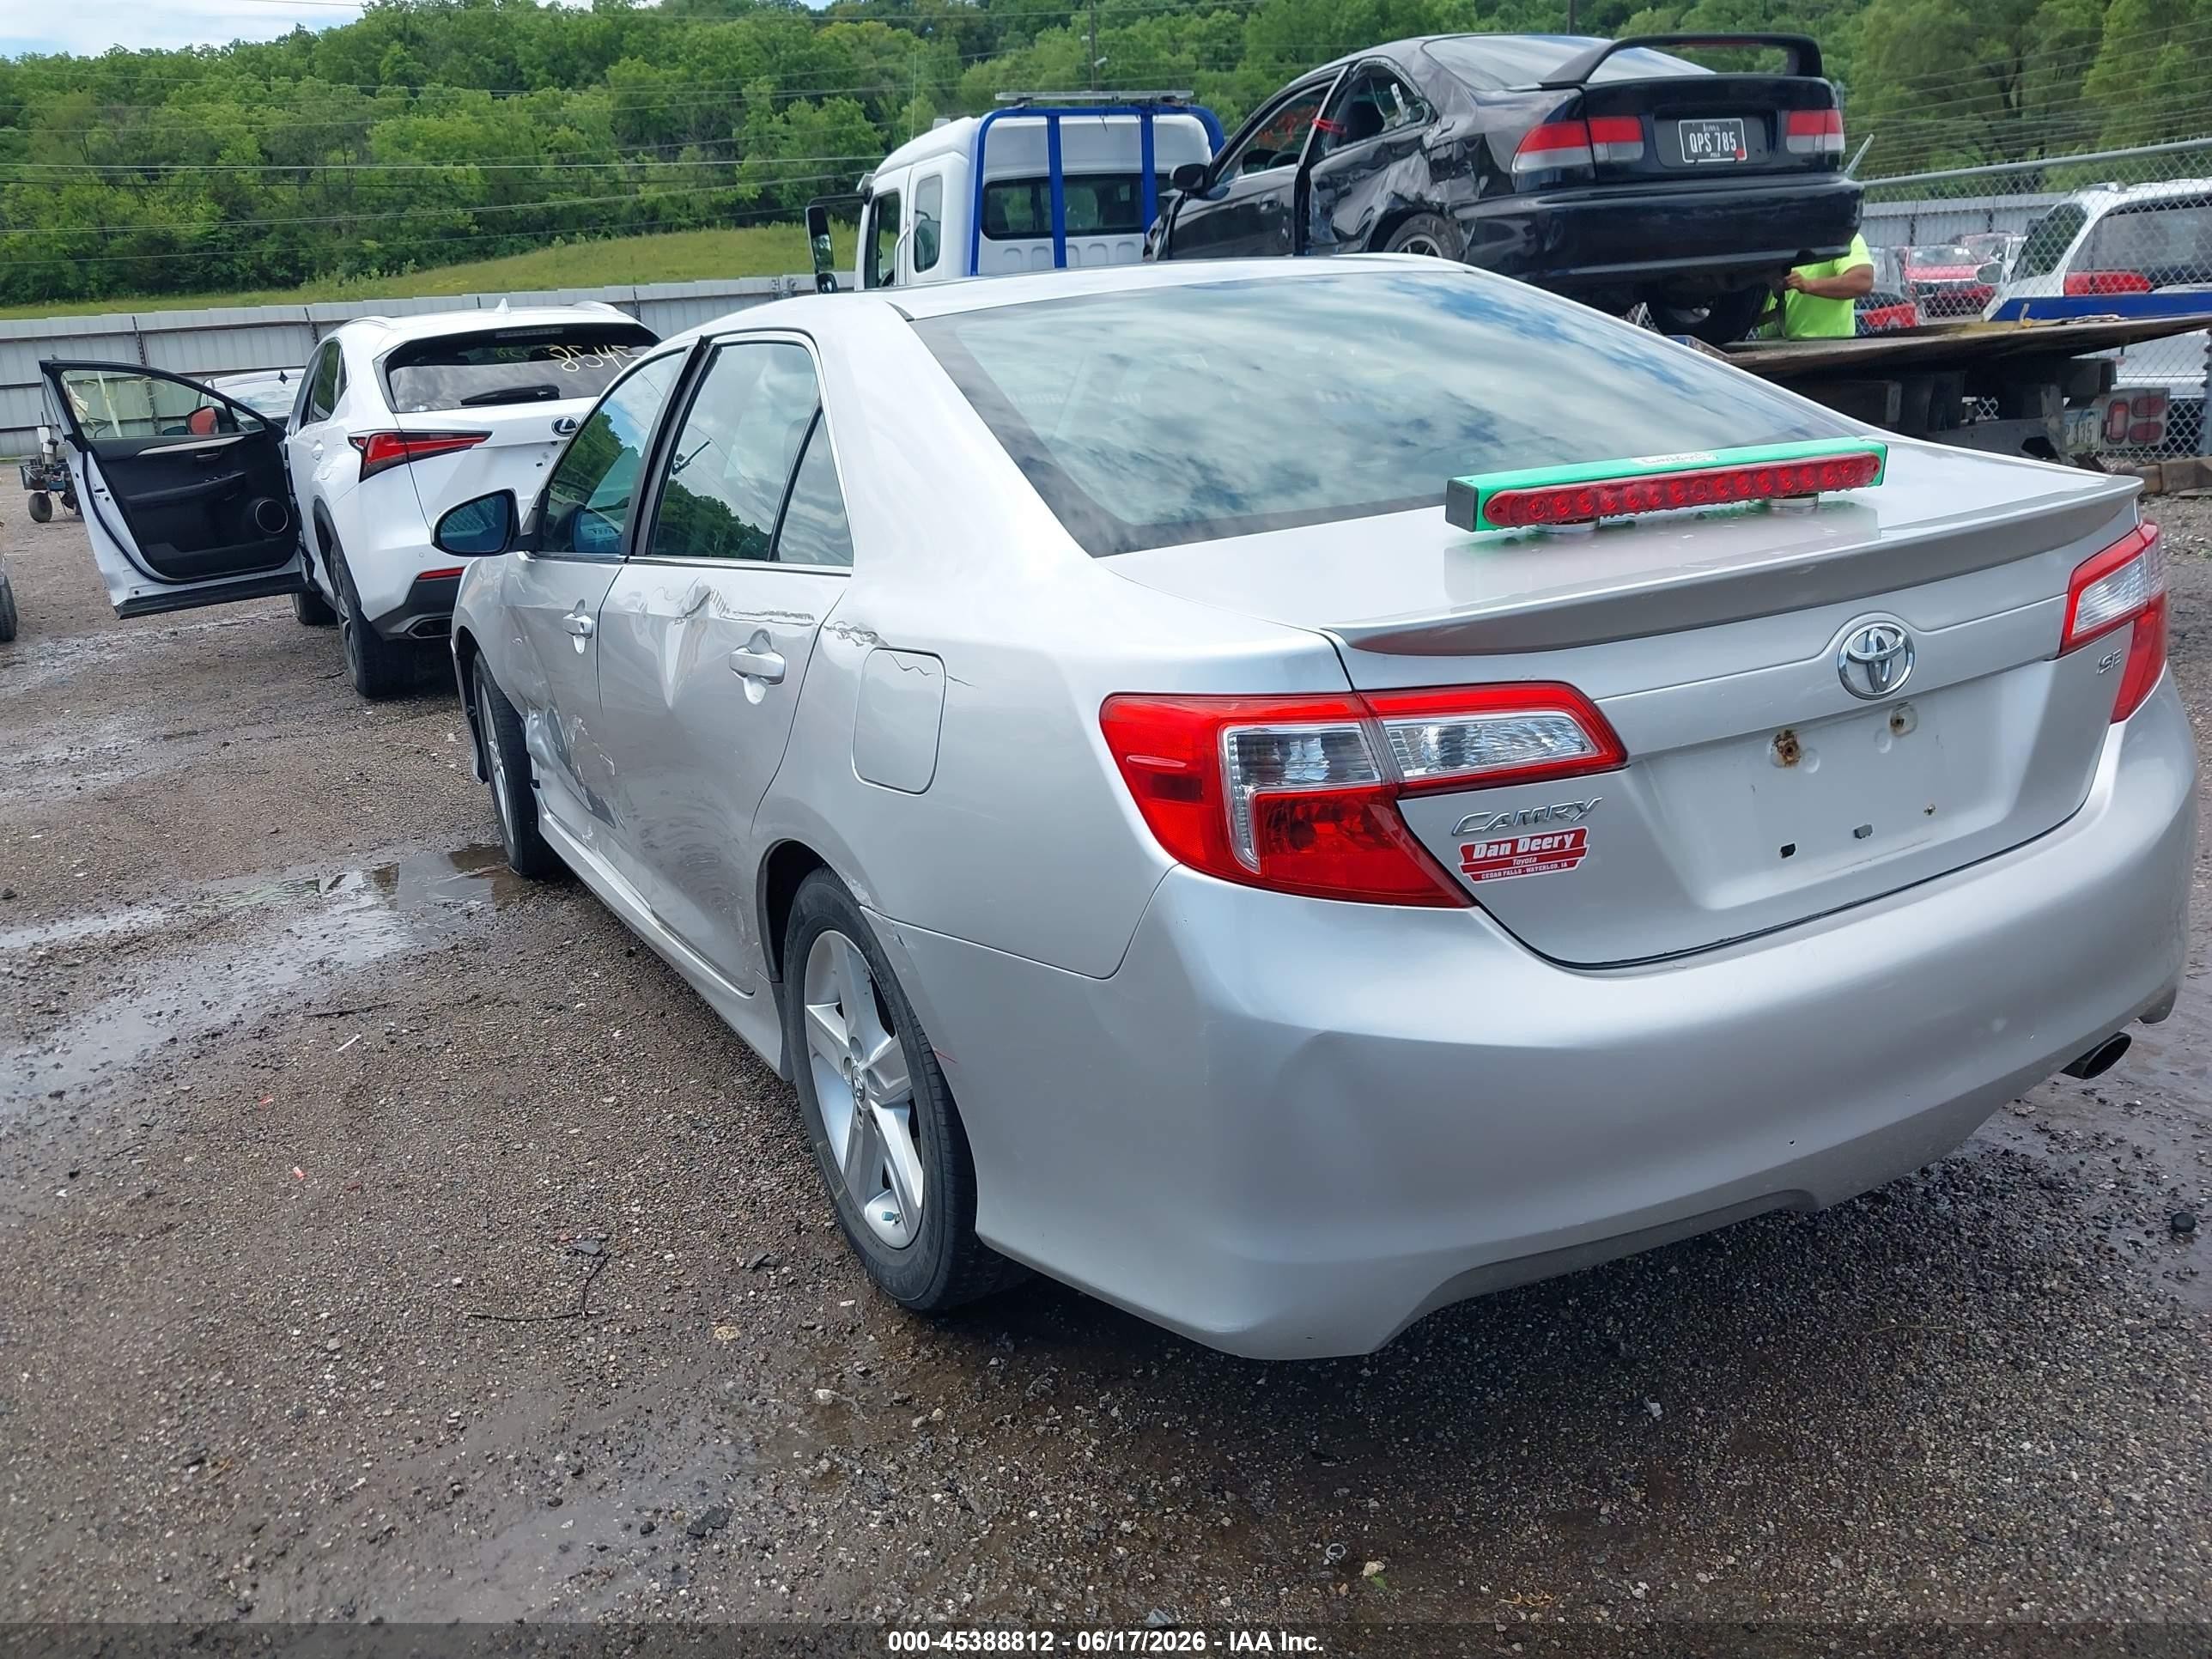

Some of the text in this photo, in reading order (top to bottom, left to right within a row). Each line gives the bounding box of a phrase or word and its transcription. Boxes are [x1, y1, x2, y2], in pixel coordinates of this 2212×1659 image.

[1689, 131, 1737, 153] QPS 785
[2096, 648, 2122, 674] SE
[1451, 797, 1603, 836] CAMRY
[1473, 833, 1576, 860] Dan Deery
[1512, 856, 1537, 866] Toyota
